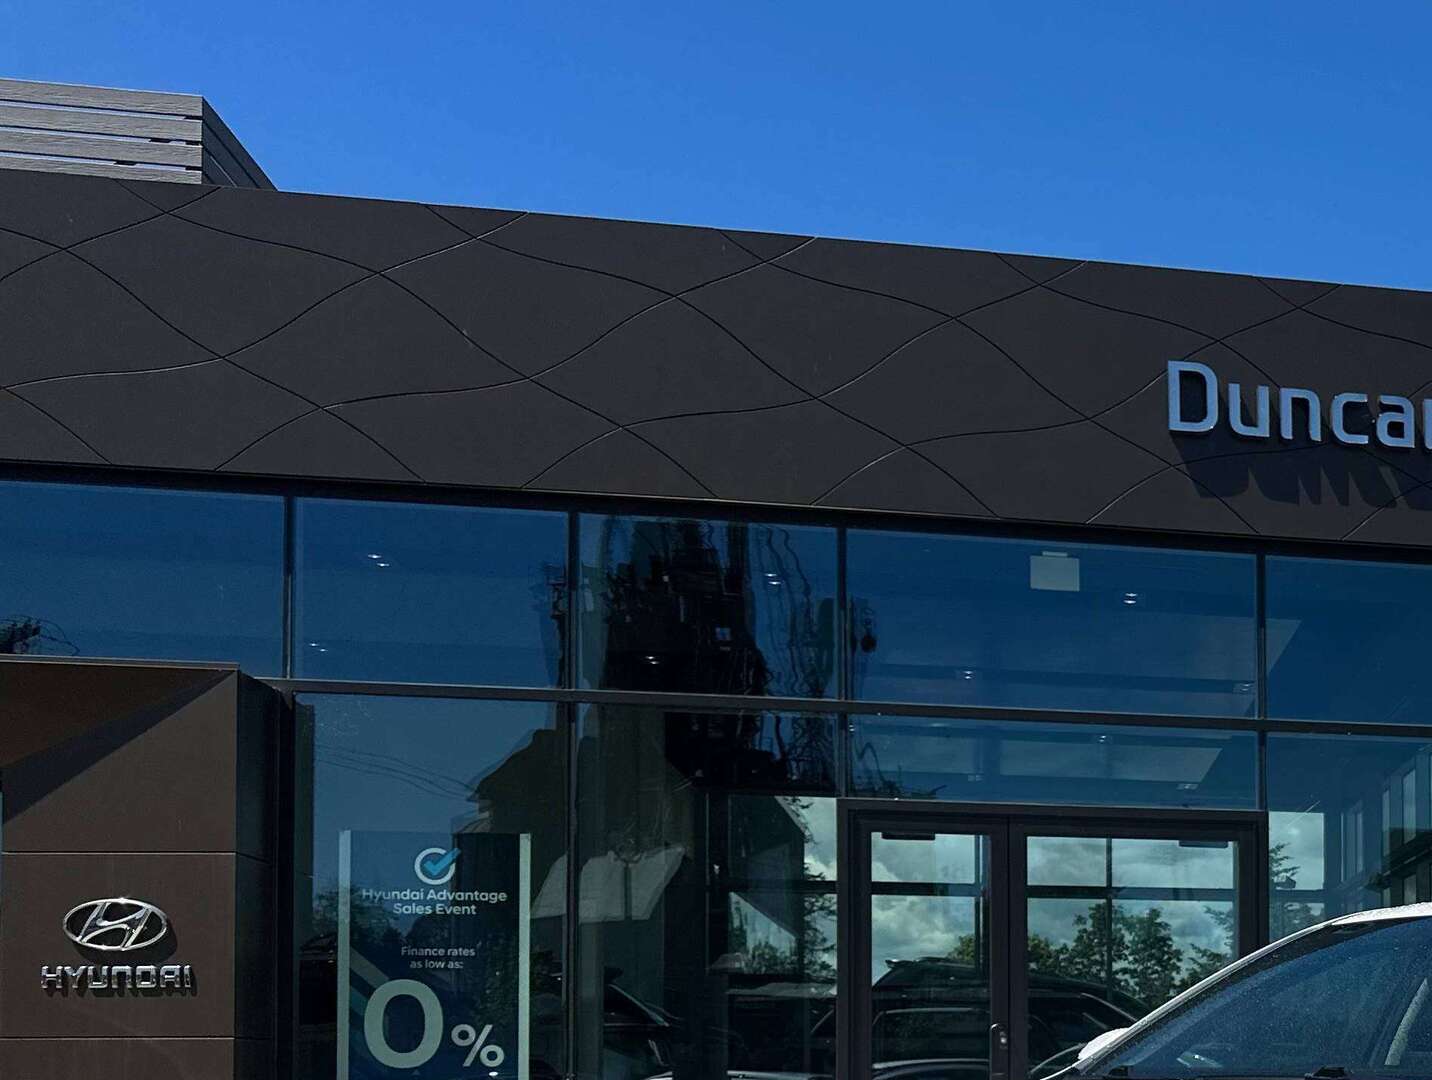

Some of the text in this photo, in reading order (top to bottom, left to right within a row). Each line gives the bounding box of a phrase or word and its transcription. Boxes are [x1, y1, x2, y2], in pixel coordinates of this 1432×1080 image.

[362, 888, 507, 903] Hyundai Advantage
[393, 903, 477, 915] Sales Event
[401, 946, 476, 957] Finance rates
[410, 958, 464, 969] as low as:
[41, 965, 192, 989] HYUNDAI
[364, 979, 505, 1069] 0%
